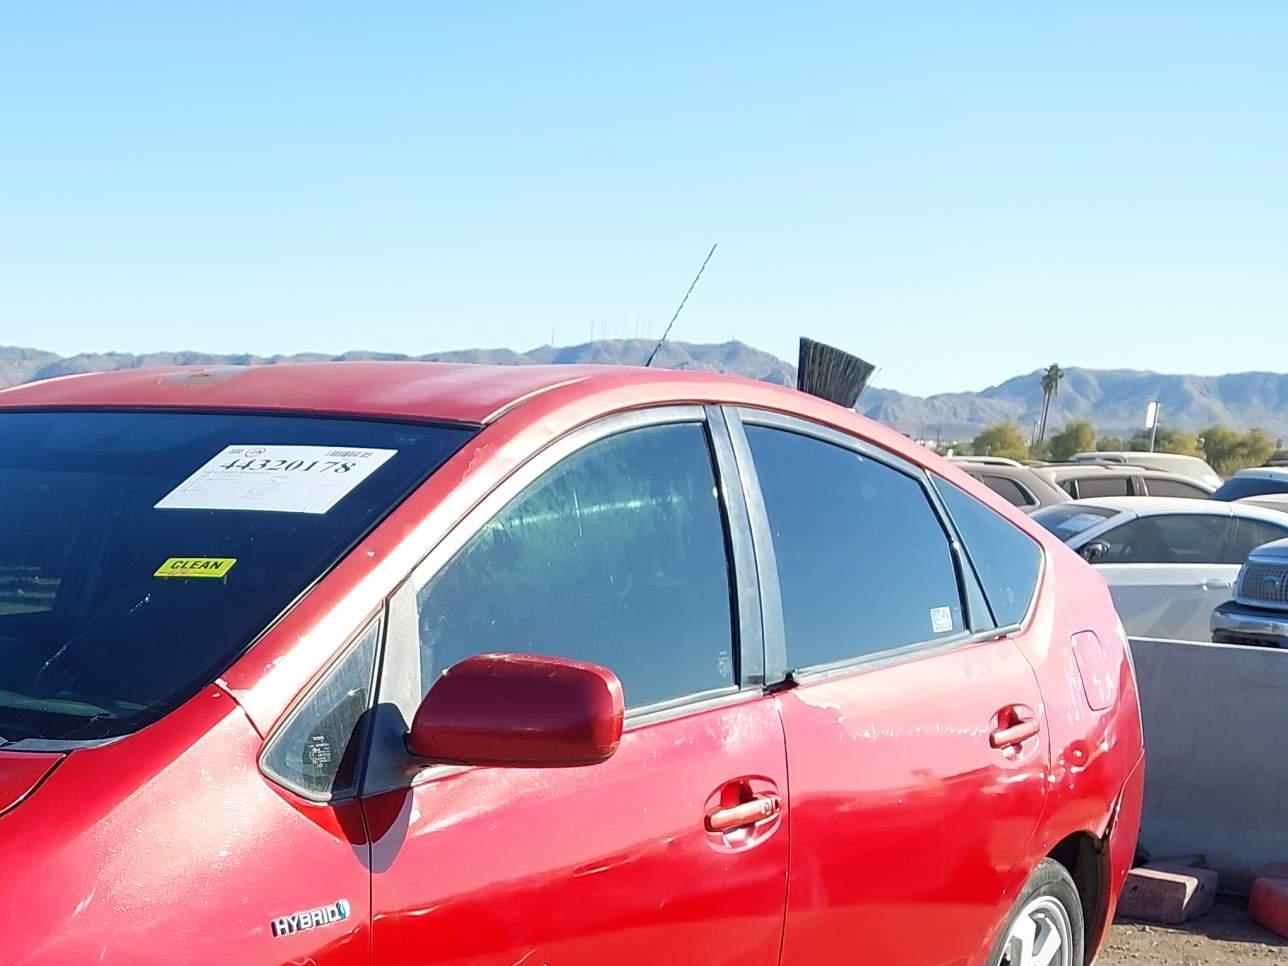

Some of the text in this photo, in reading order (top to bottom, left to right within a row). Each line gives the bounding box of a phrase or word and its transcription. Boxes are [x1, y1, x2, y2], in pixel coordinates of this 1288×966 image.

[219, 457, 356, 474] 44320178
[170, 560, 224, 570] CLEAN
[271, 905, 340, 937] HYBRID
